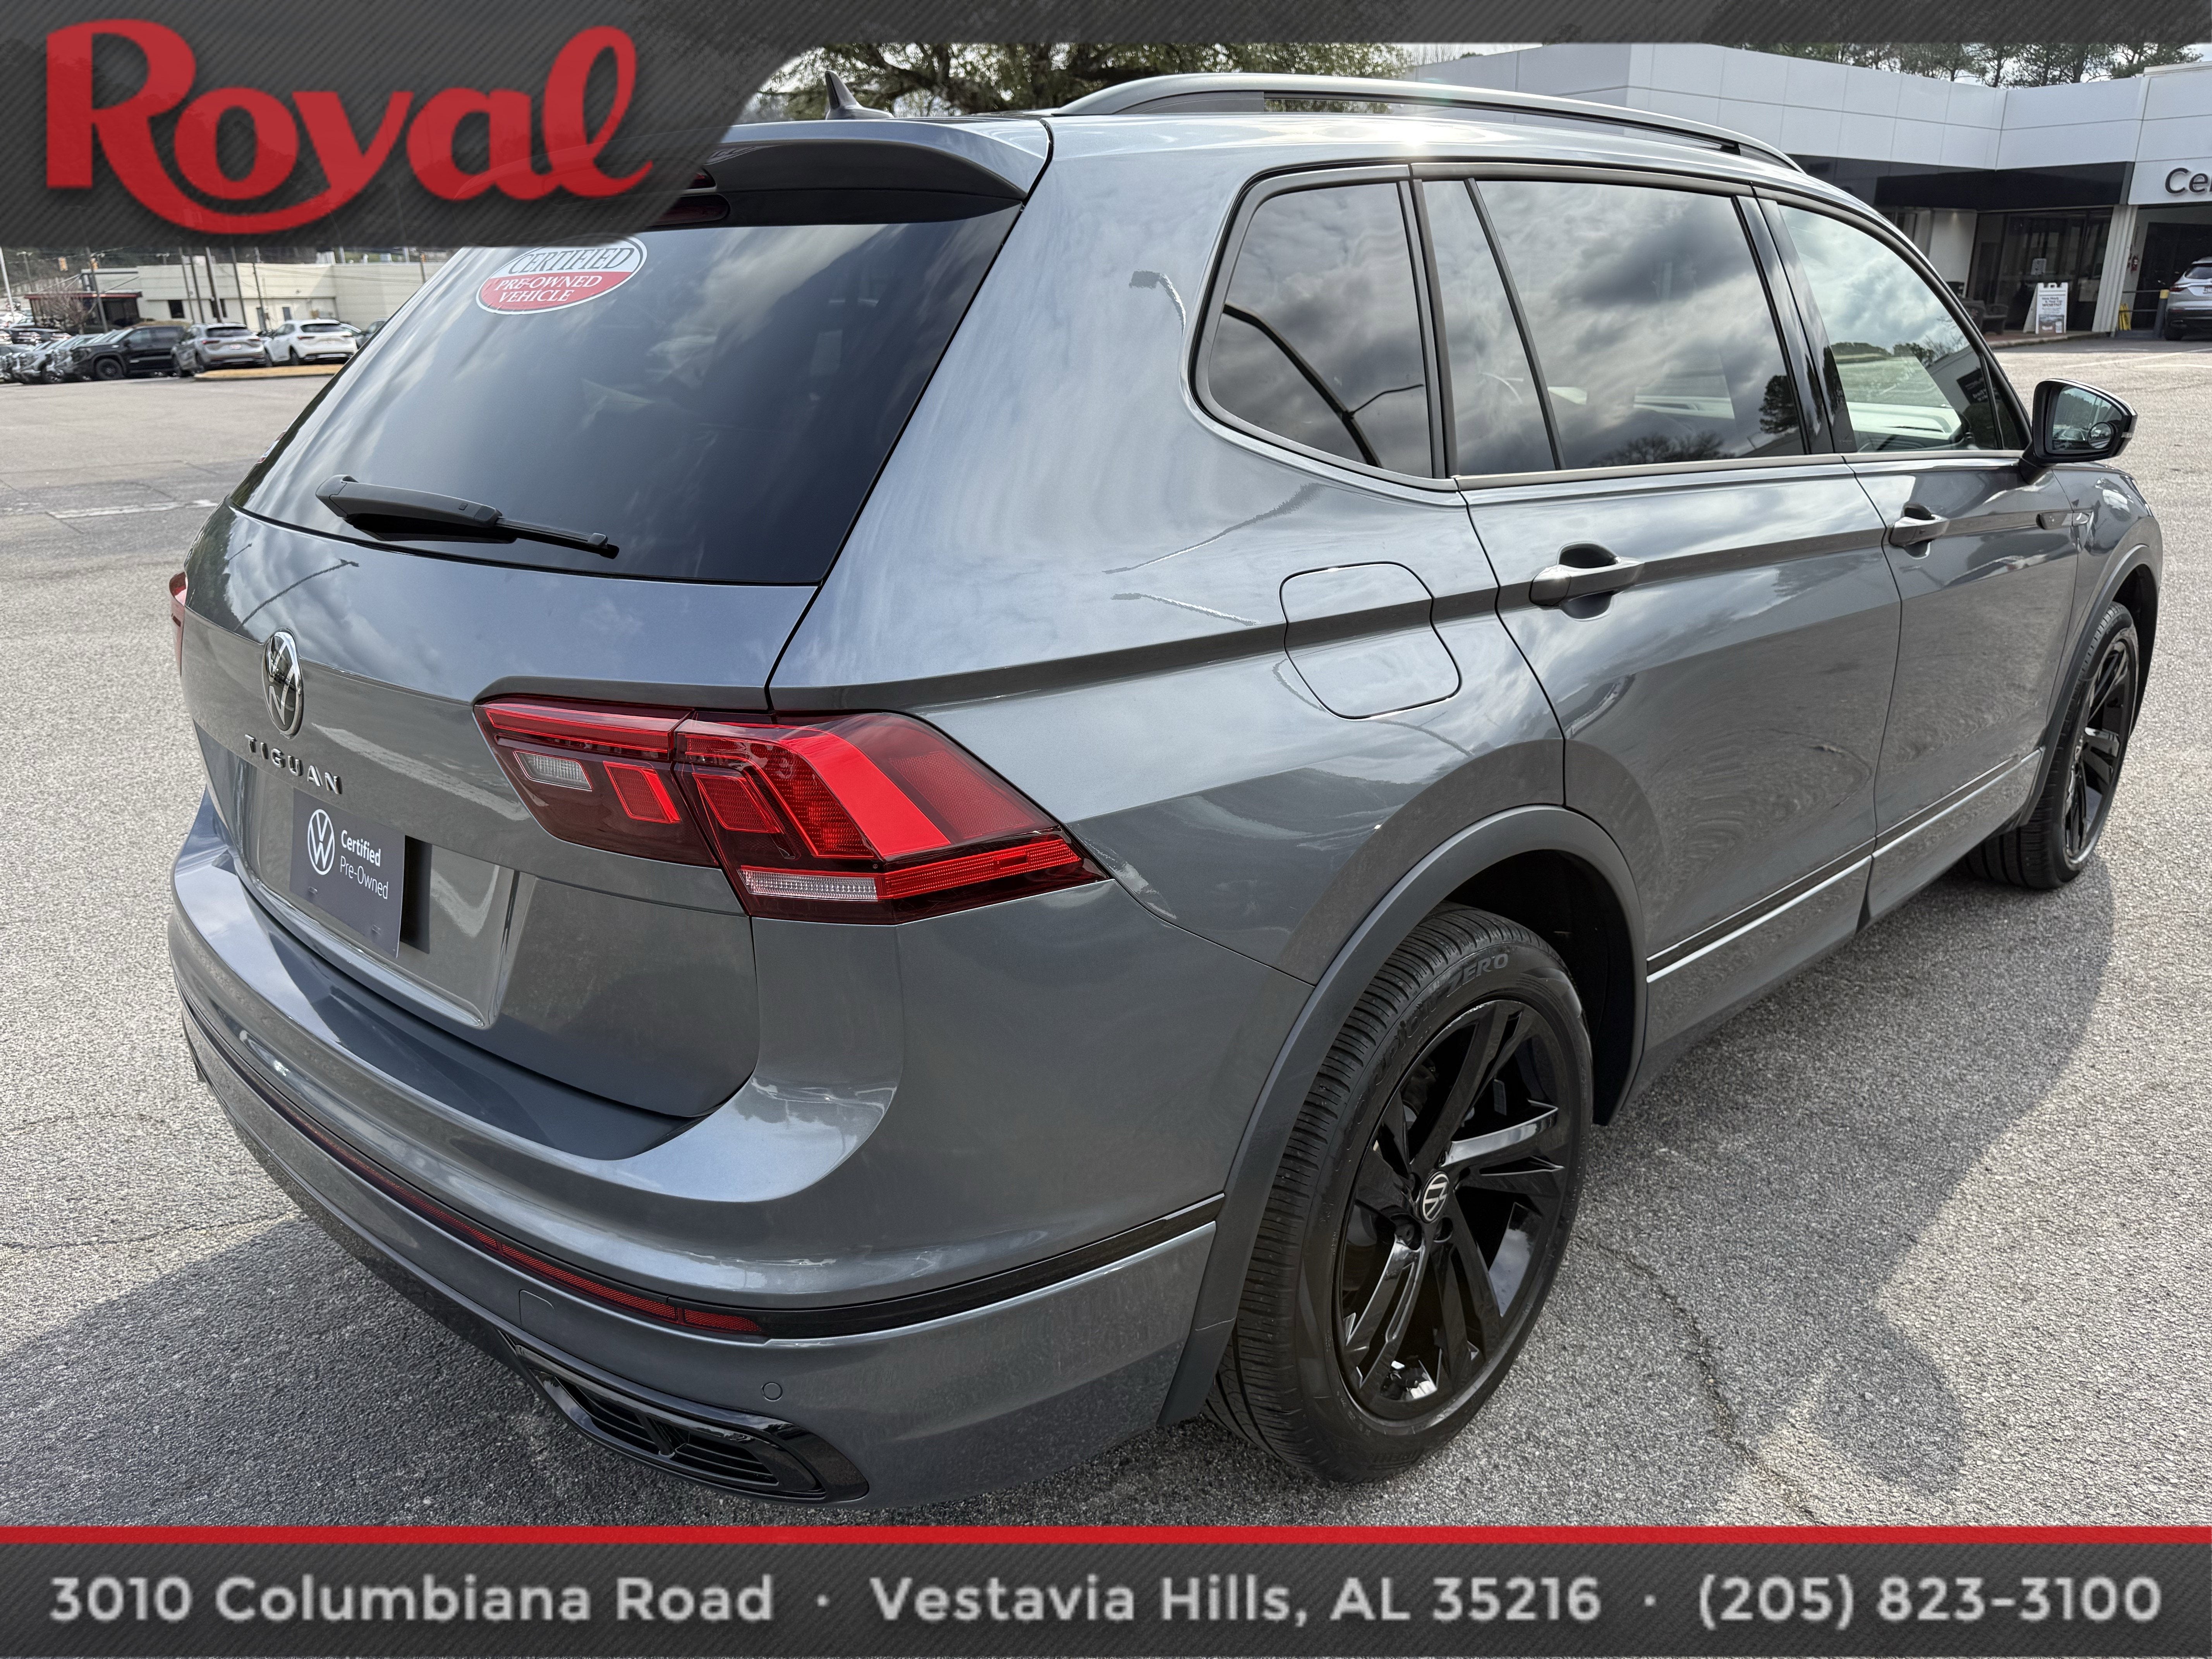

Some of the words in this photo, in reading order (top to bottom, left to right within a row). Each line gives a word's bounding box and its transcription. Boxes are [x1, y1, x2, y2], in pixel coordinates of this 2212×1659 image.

[508, 248, 634, 274] CERTIFIED
[494, 275, 603, 291] PRE-OWNED
[499, 289, 575, 304] VEHICLE
[245, 734, 343, 794] TIGUAN
[341, 830, 381, 867] Certified
[340, 855, 389, 900] Pre-Owned
[1447, 953, 1509, 998] ZERO
